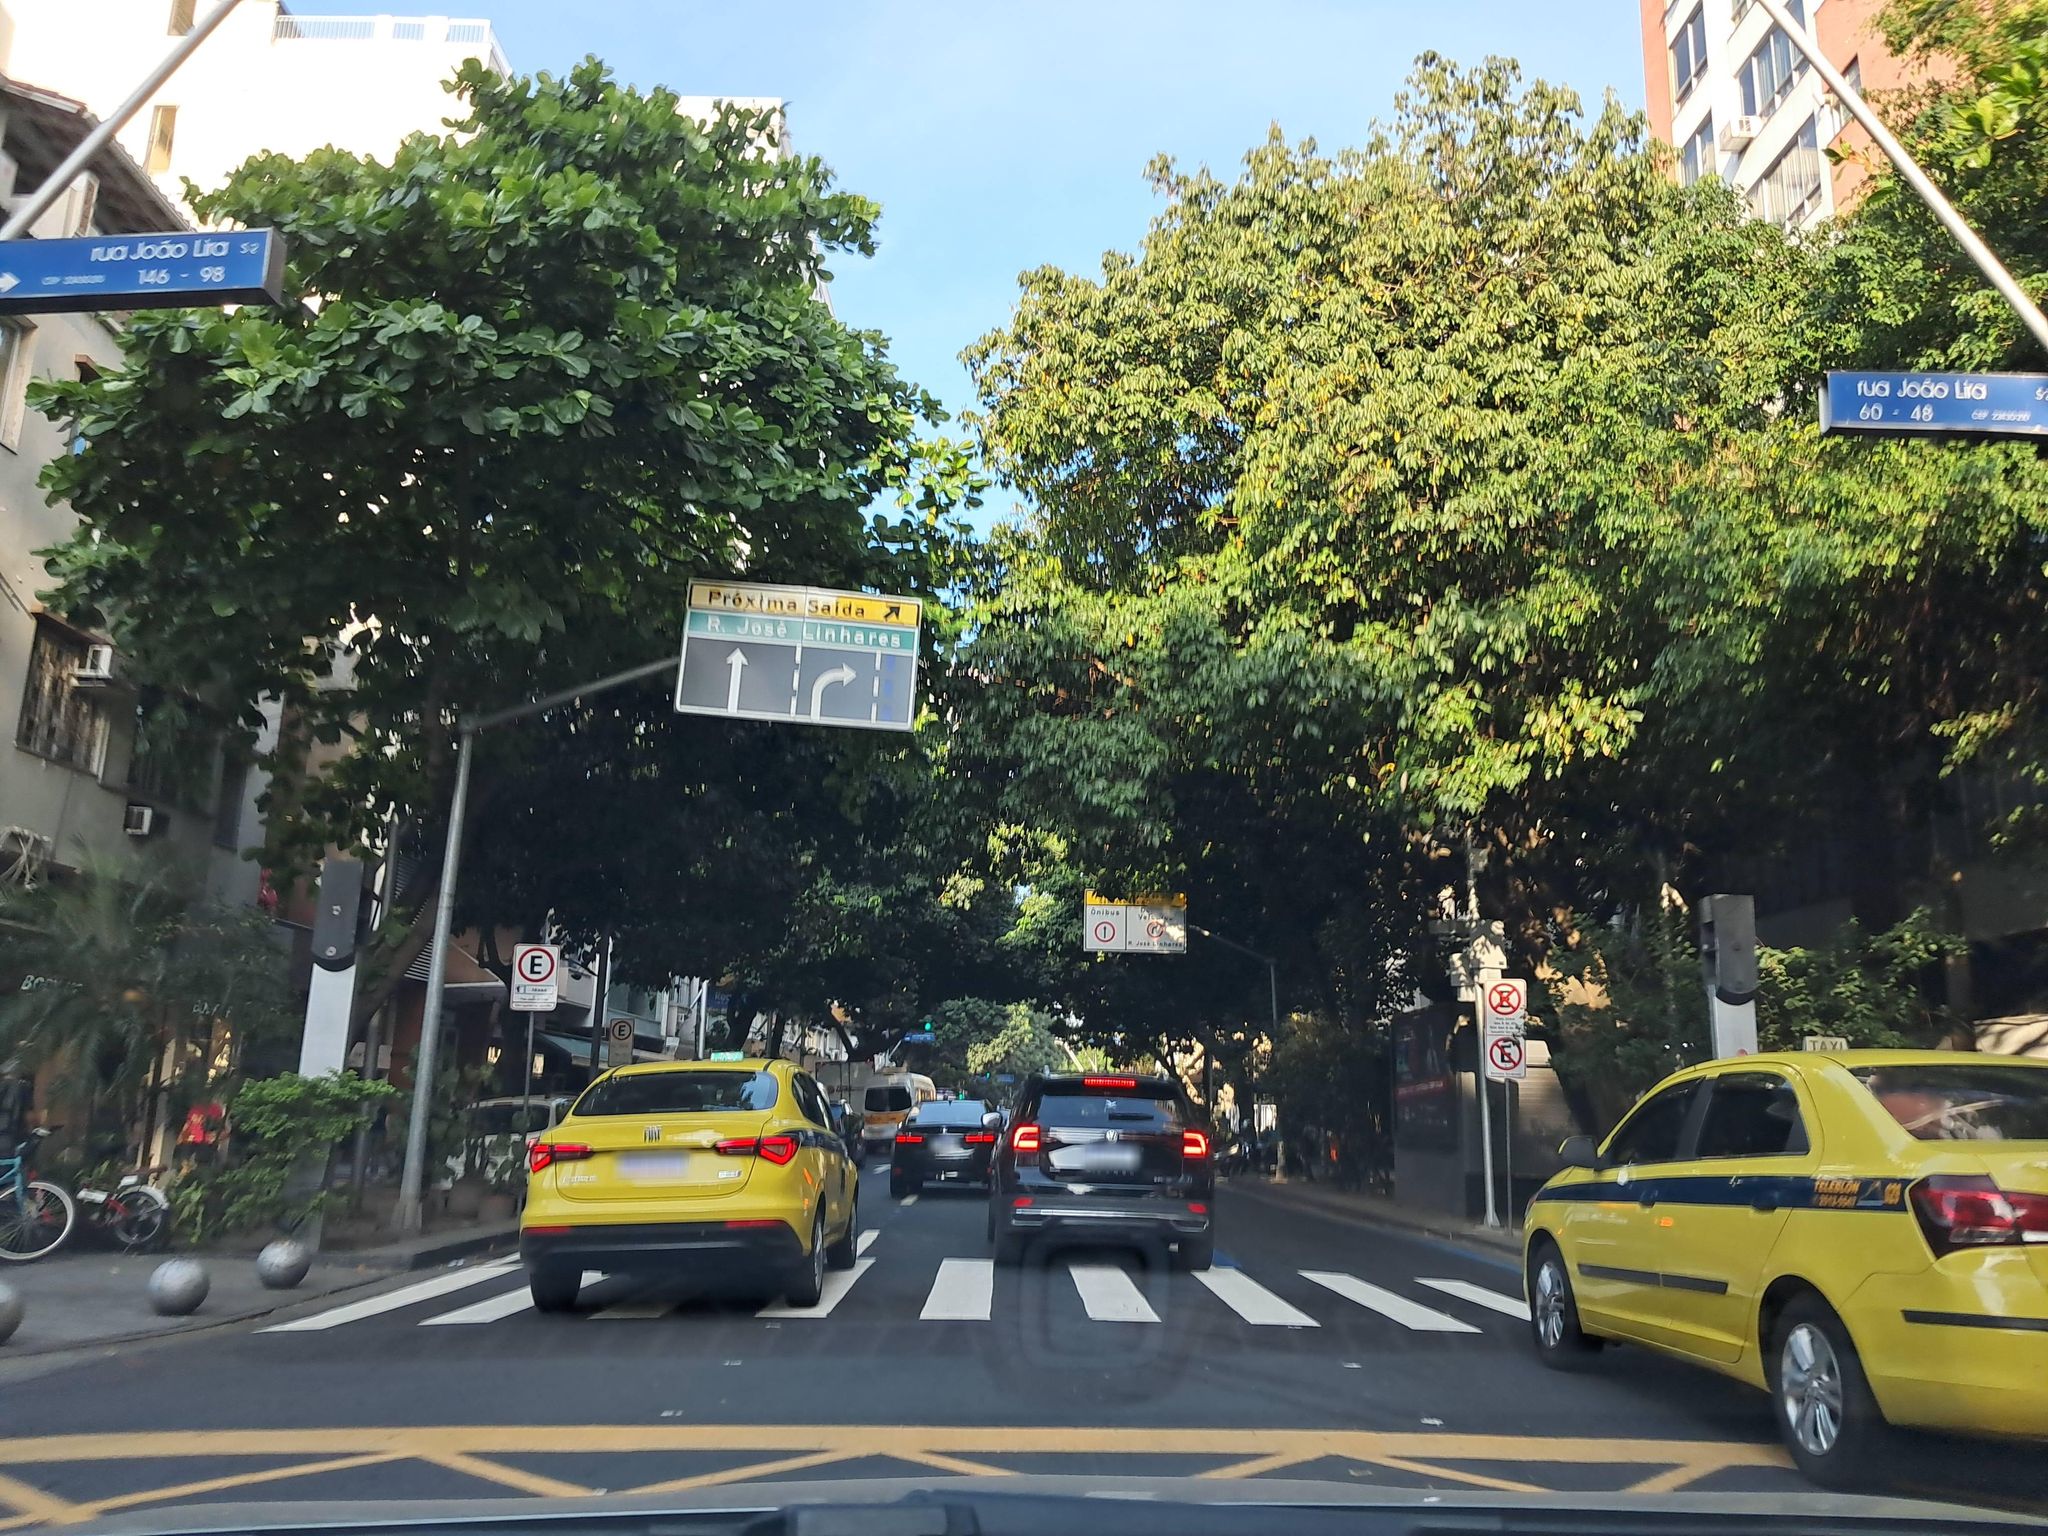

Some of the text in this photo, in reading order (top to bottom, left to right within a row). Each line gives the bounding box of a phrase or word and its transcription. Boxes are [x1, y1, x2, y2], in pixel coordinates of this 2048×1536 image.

[90, 238, 230, 262] rua João Lira
[138, 268, 170, 285] 146
[200, 266, 226, 283] 98
[1857, 377, 1988, 400] rua João Lira
[1859, 402, 1884, 421] 60
[1910, 403, 1935, 422] 48
[708, 589, 866, 619] Próxima Saída
[707, 615, 902, 648] R. José Linhares
[529, 955, 543, 975] E
[618, 1024, 626, 1036] E
[1809, 1040, 1843, 1051] TAXI
